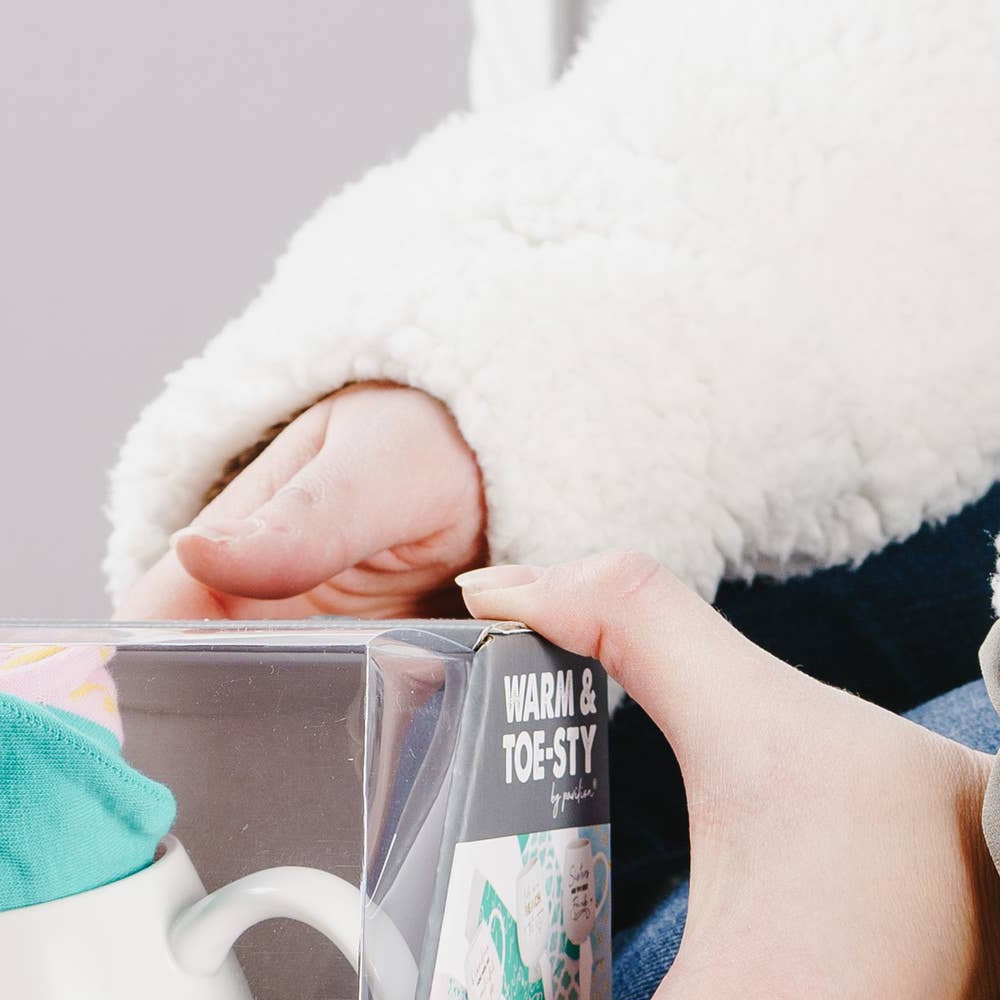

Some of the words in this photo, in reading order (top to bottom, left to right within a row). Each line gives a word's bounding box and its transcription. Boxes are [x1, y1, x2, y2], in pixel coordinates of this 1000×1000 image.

[504, 669, 574, 723] WARM
[580, 667, 597, 716] &
[503, 724, 597, 784] TOE-STY
[550, 781, 562, 819] by
